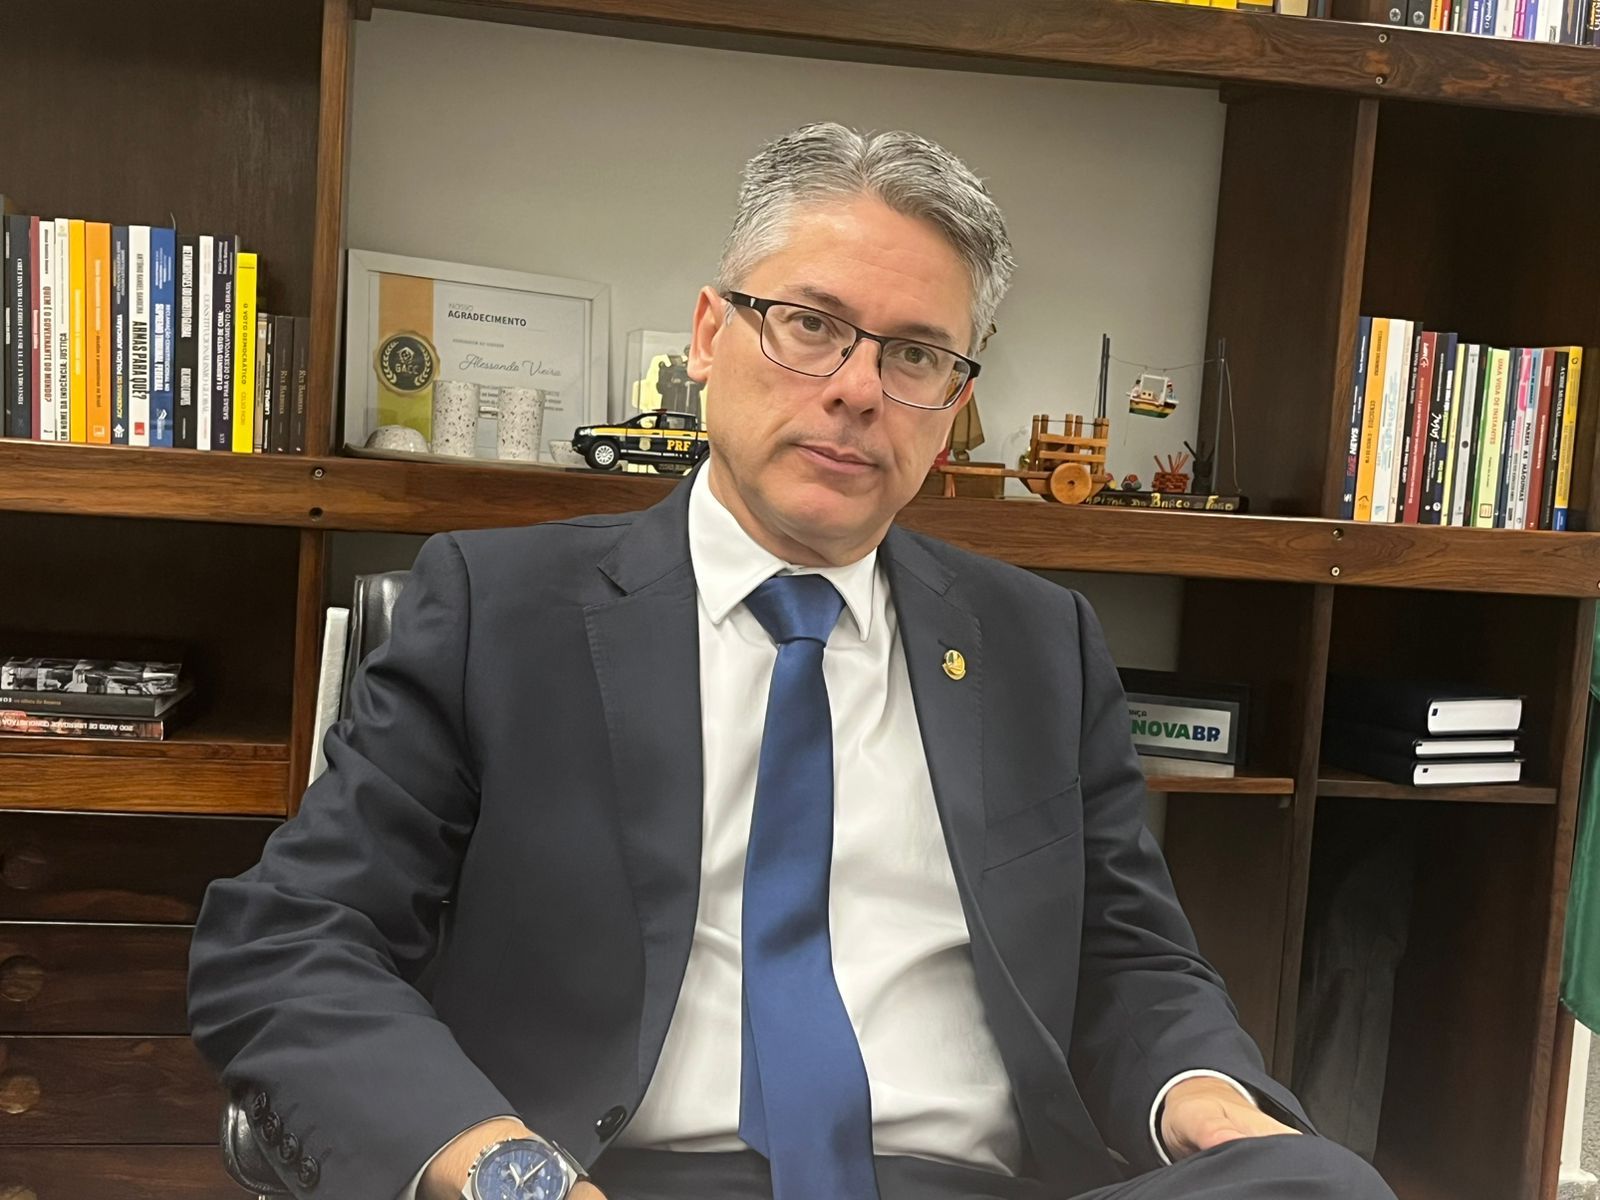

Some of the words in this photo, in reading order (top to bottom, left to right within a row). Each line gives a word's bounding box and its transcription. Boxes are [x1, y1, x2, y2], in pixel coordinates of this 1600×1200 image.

[447, 310, 527, 327] AGRADECIMENTO
[60, 333, 68, 360] JUSTIÇA
[132, 321, 148, 352] ARMAS
[132, 353, 148, 376] PARA
[1496, 358, 1504, 376] UMA
[129, 377, 150, 400] QUÊ?
[1493, 377, 1502, 395] VIDA
[1493, 396, 1500, 406] DE
[60, 411, 68, 429] NOME
[1488, 407, 1499, 444] INSTANTES
[1348, 427, 1359, 454] NEWS
[1523, 422, 1531, 446] PAREM
[666, 439, 691, 452] PRF
[1522, 450, 1528, 459] AS
[1346, 455, 1356, 476] FAKE
[1517, 463, 1528, 501] MÁQUINAS
[88, 722, 98, 730] DE
[1130, 719, 1221, 742] NOVABR
